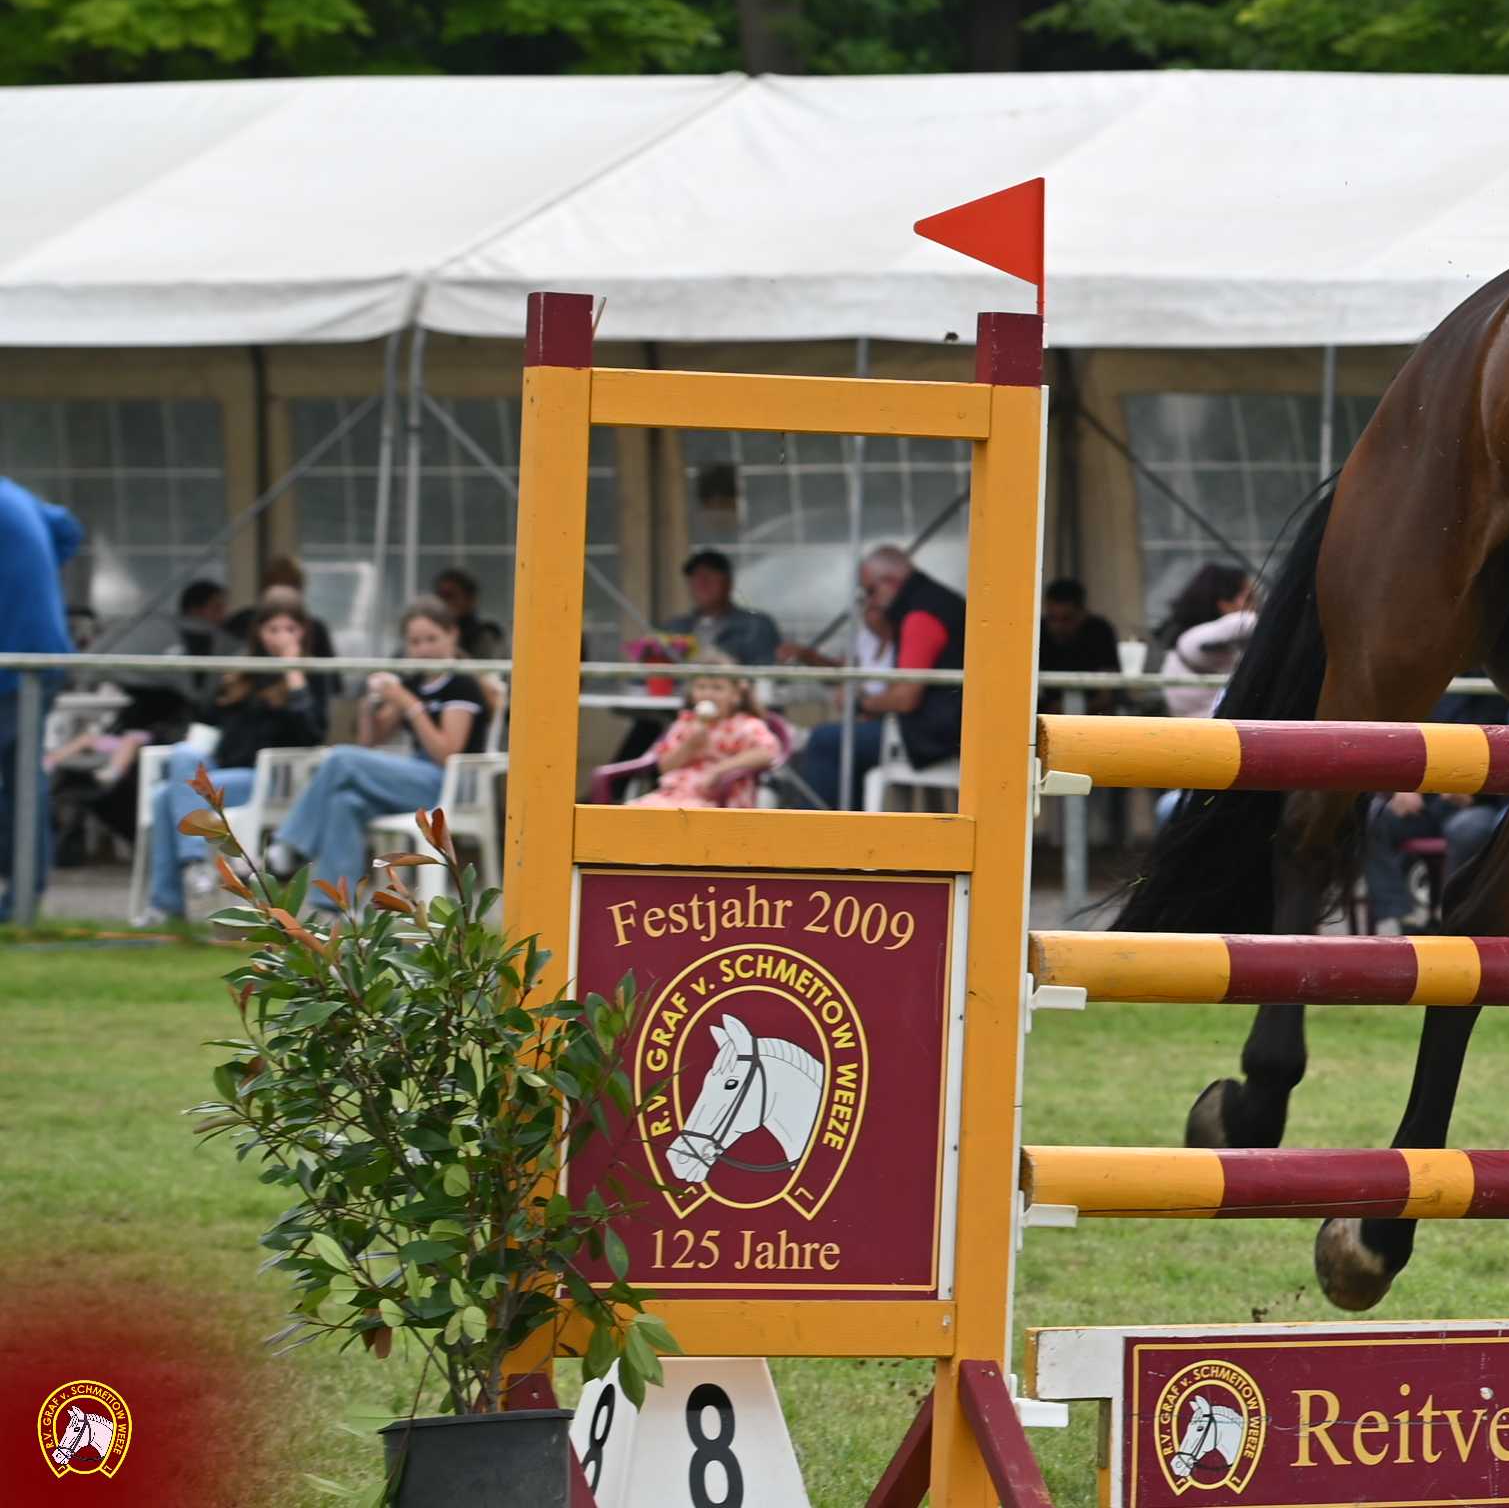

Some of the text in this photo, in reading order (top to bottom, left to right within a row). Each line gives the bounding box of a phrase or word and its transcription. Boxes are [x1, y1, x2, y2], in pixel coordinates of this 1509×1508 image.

[607, 884, 915, 950] Festjahr 2009
[645, 991, 690, 1072] GRAF
[694, 976, 716, 996] v.
[719, 954, 856, 1050] SCHMETTOW
[823, 1063, 858, 1150] WEEZE
[650, 1229, 841, 1270] 125 Jahre
[686, 1383, 744, 1508] 8
[1160, 1386, 1180, 1424] GRAF
[1180, 1376, 1192, 1387] v.
[1193, 1367, 1258, 1409] SCHMETTOW
[1244, 1416, 1261, 1458] WEEZE
